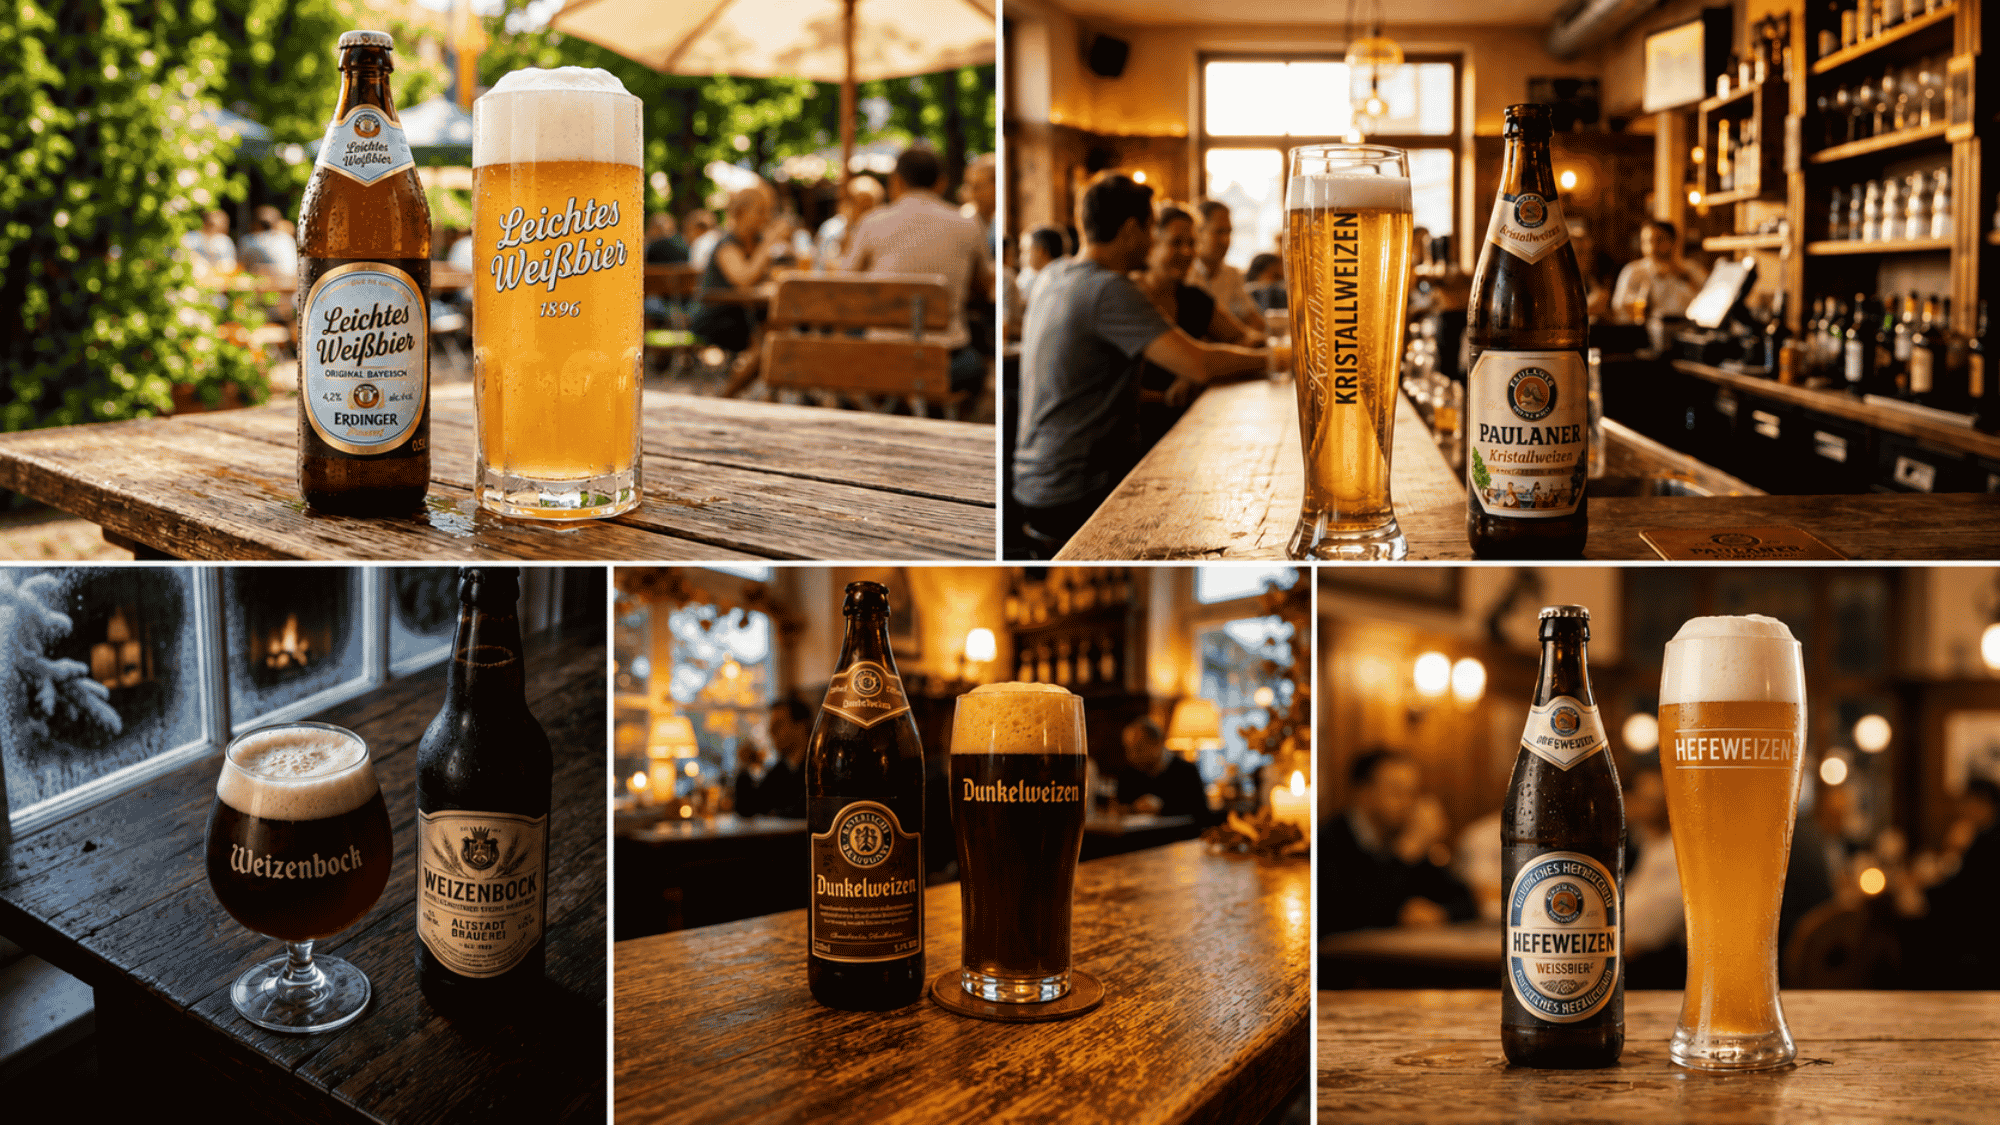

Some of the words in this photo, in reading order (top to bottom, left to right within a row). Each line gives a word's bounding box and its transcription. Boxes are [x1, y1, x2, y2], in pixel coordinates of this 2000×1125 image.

[496, 196, 620, 250] Leichtes
[490, 237, 628, 293] Weißbier
[321, 302, 409, 336] Leichtes
[539, 300, 581, 318] 1896
[1333, 212, 1358, 405] KRISTALLWEIZEN
[316, 331, 416, 367] Weißbier
[324, 369, 364, 378] ORIGINAL
[334, 411, 399, 427] ERDINGER
[1479, 423, 1581, 445] PAULANER
[1489, 448, 1573, 464] Kristallweizen
[1675, 737, 1791, 761] HEFEWEIZEN
[962, 777, 1079, 803] Dunkelweizen
[230, 843, 363, 880] Weizenbock
[424, 867, 537, 903] WEIZENBOCK
[816, 874, 916, 898] Dunkelweizen
[451, 918, 506, 931] ALTSTADT
[451, 928, 506, 941] BRAUEREI
[1513, 932, 1615, 954] HEFEWEIZEN
